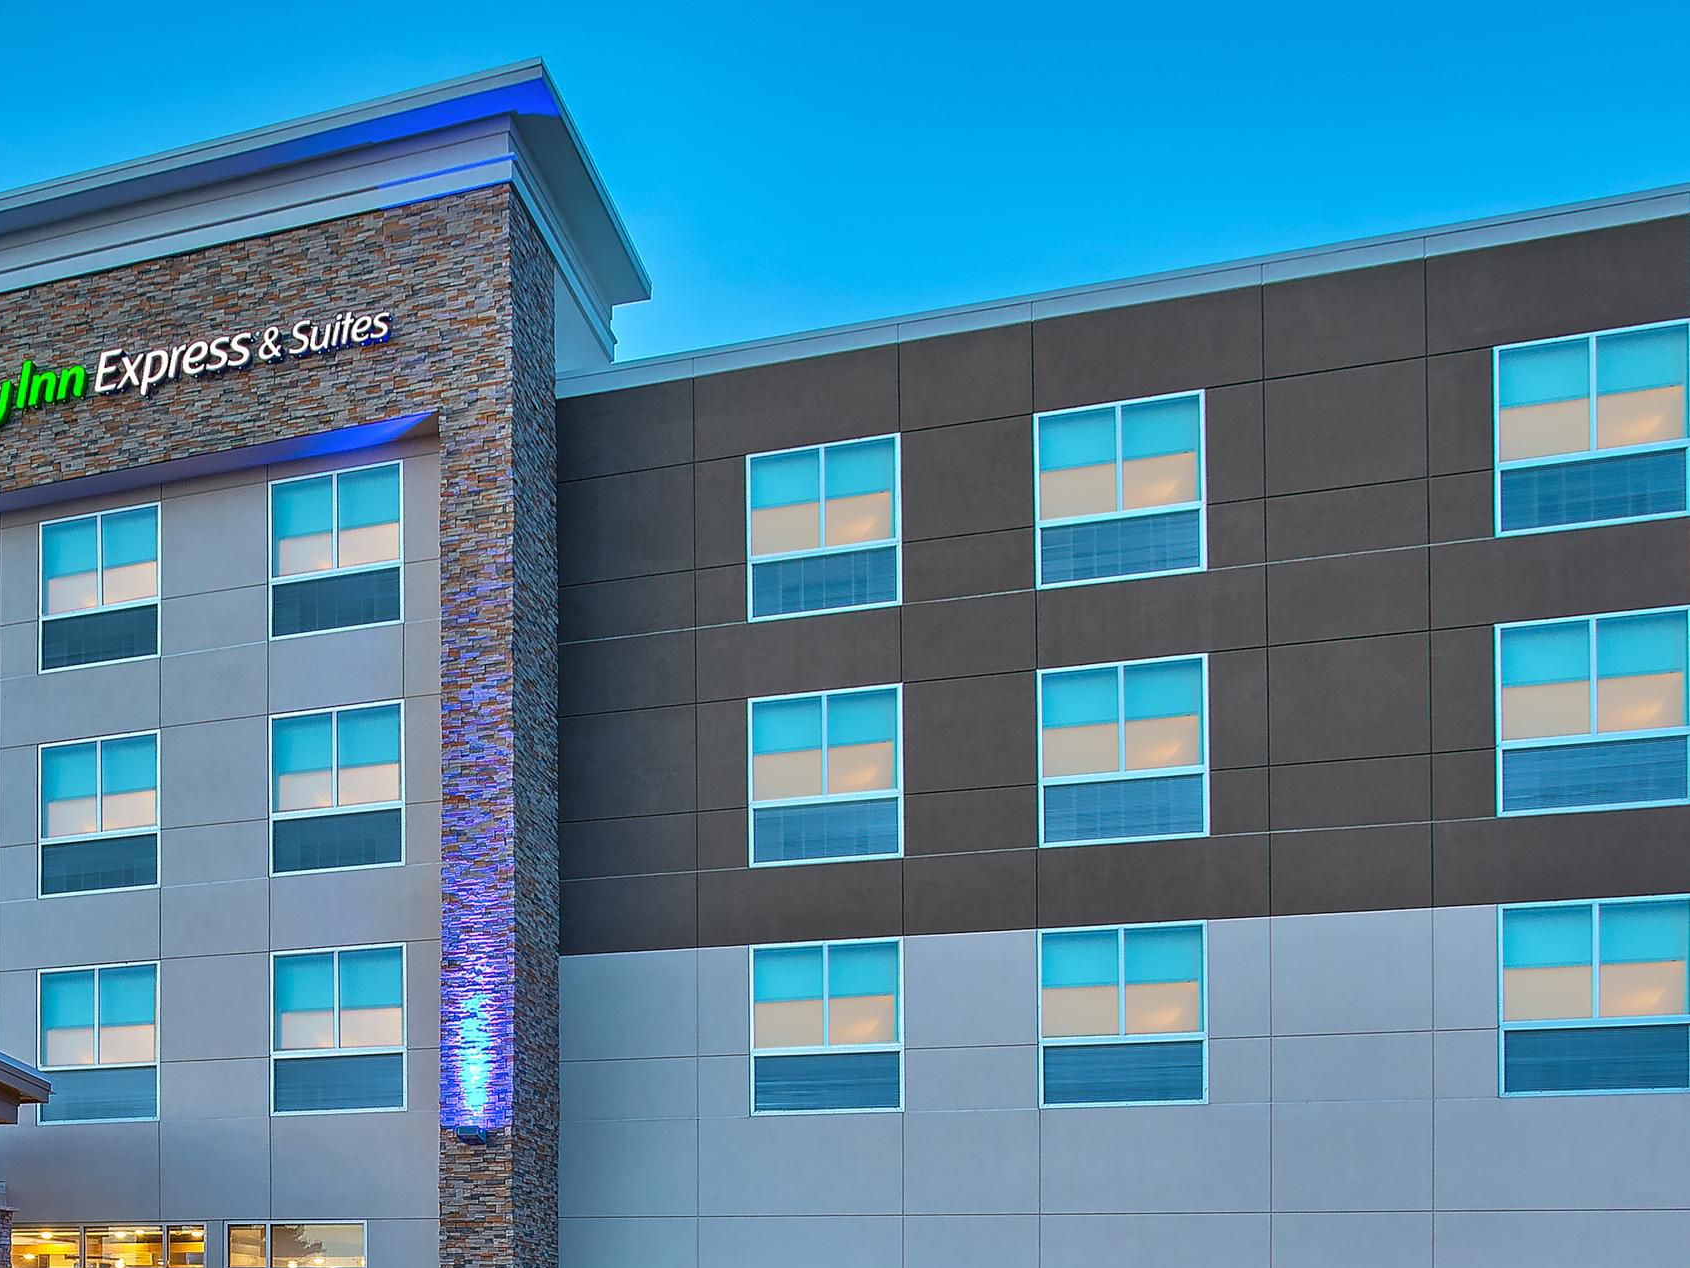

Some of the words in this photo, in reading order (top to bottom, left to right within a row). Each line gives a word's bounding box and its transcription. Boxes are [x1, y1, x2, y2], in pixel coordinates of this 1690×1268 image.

[14, 359, 88, 410] Inn
[94, 331, 255, 396] Express
[257, 326, 283, 361] &
[288, 311, 392, 355] Suites
